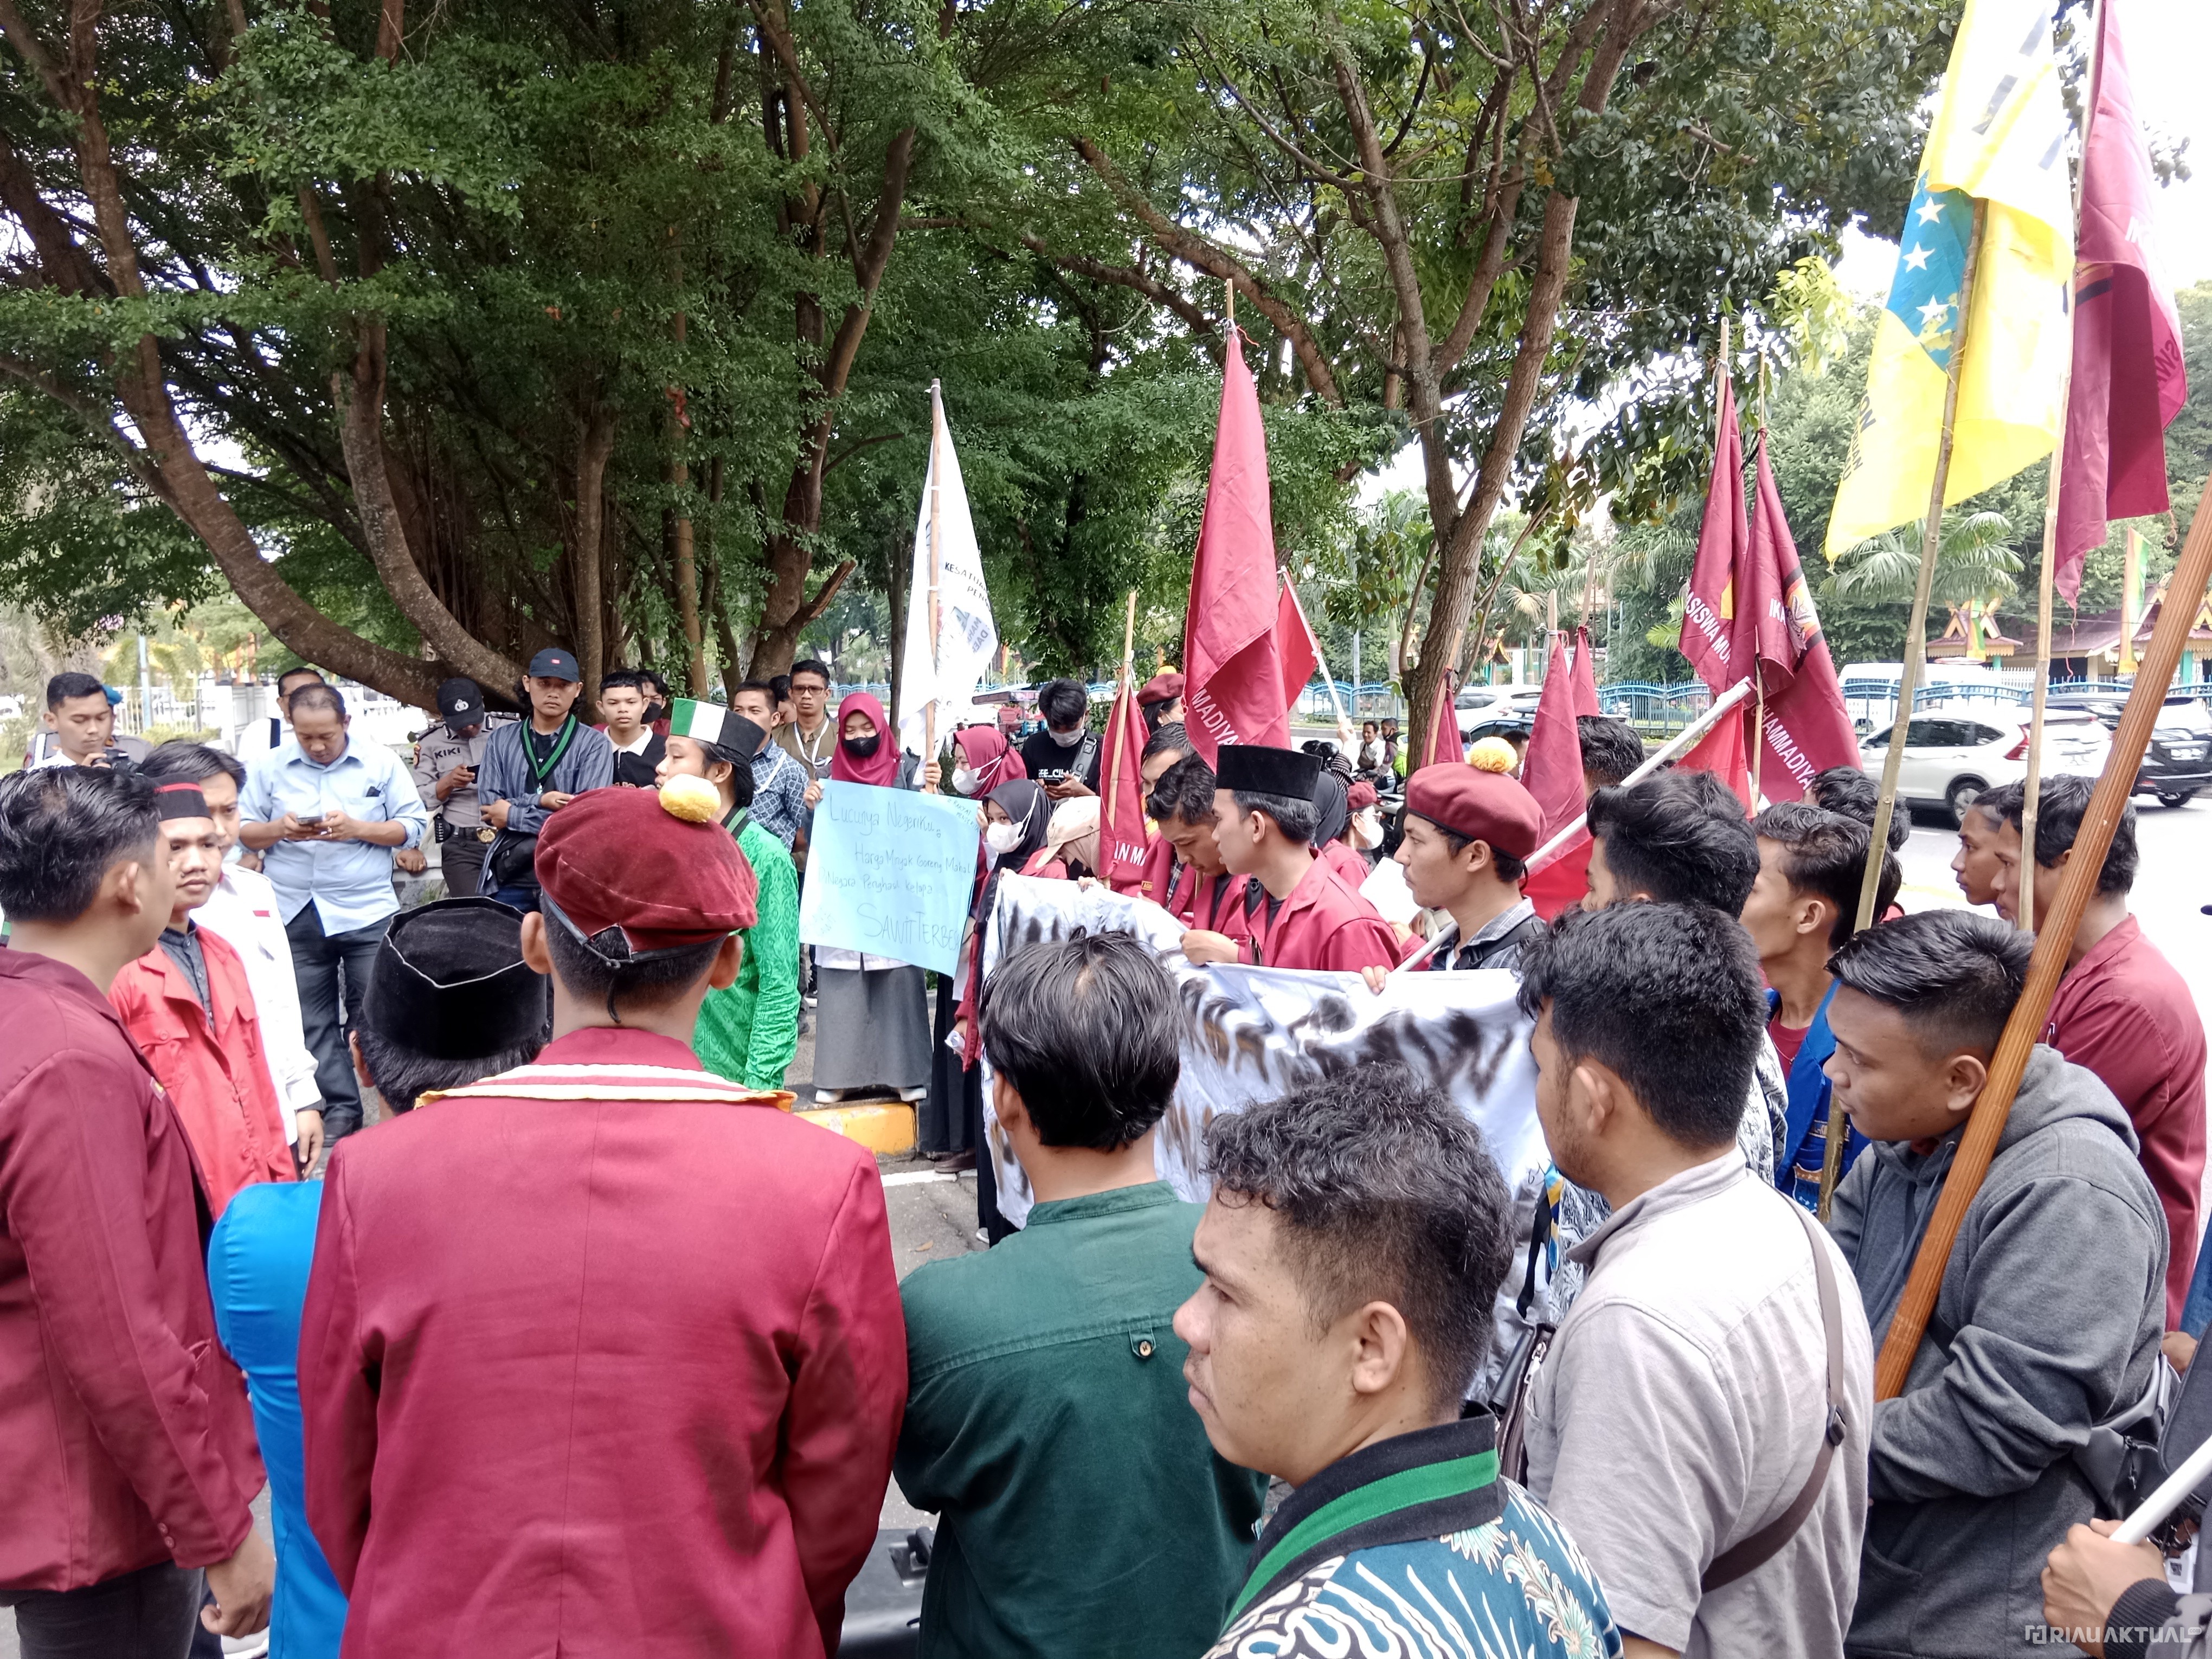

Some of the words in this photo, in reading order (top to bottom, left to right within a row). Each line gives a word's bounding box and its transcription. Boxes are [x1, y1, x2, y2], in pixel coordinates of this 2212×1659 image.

[1859, 389, 1876, 434] ON
[1192, 688, 1244, 746] MADIYA
[435, 747, 460, 759] KIKI
[830, 793, 879, 835] Lucunya
[854, 842, 884, 870] Harga
[917, 854, 942, 873] Goreng
[946, 857, 970, 874] Mahal
